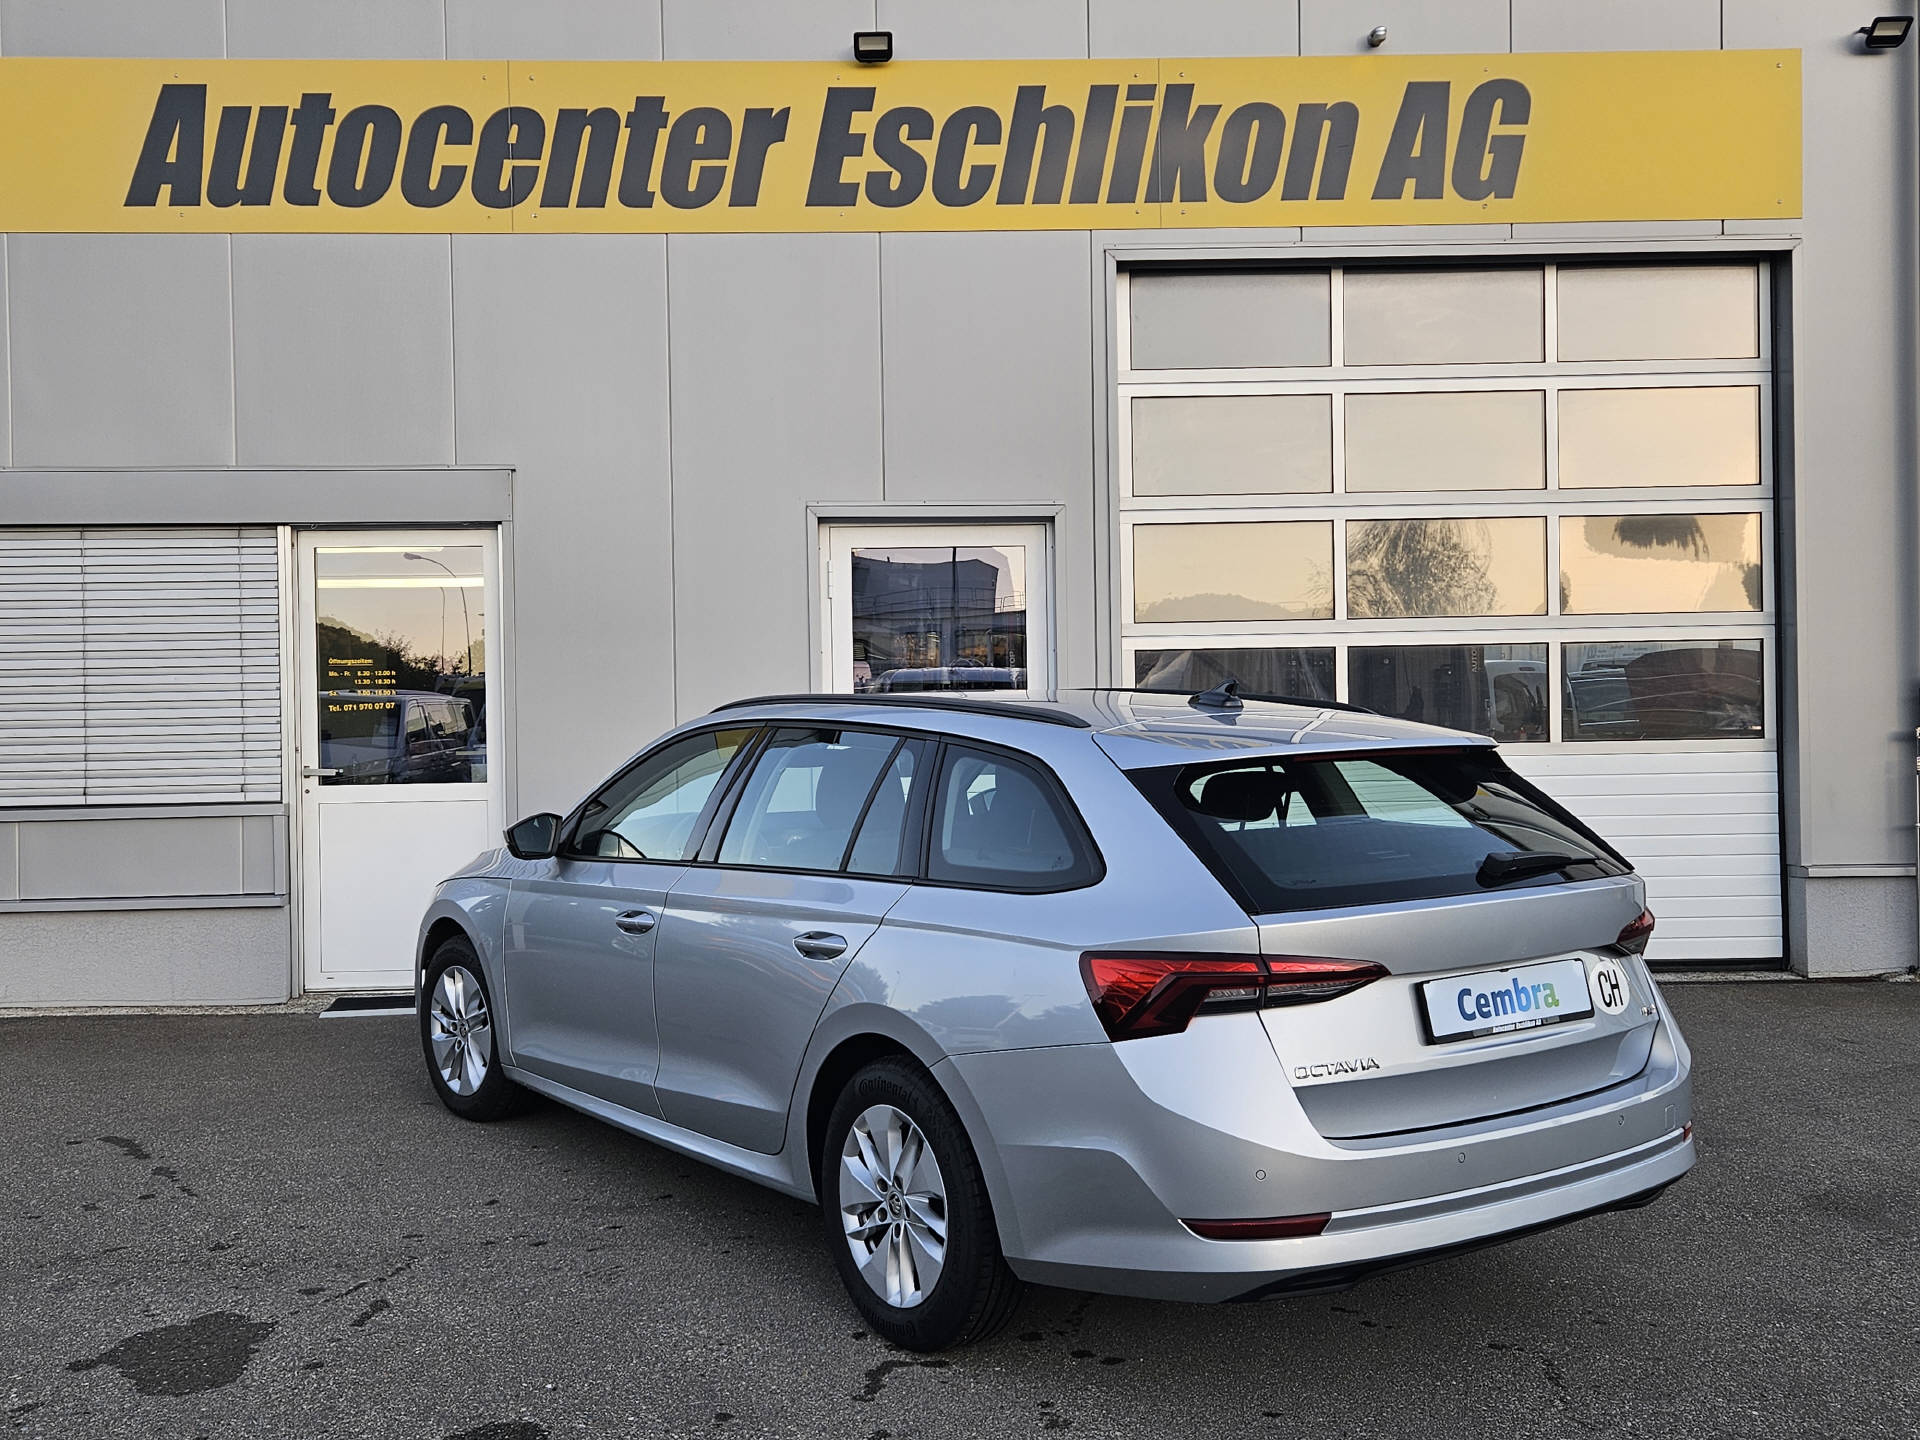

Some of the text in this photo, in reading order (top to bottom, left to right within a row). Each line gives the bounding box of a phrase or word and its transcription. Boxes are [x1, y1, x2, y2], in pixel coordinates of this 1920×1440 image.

[124, 78, 1532, 209] Autocenter Eschlikon AG
[328, 704, 342, 712] Tel.
[359, 703, 373, 711] 970
[374, 702, 384, 710] 07
[1457, 977, 1559, 1022] Cembra
[1597, 968, 1624, 1008] CH
[1294, 1057, 1380, 1079] OCTAVIA
[858, 1075, 914, 1104] Continental
